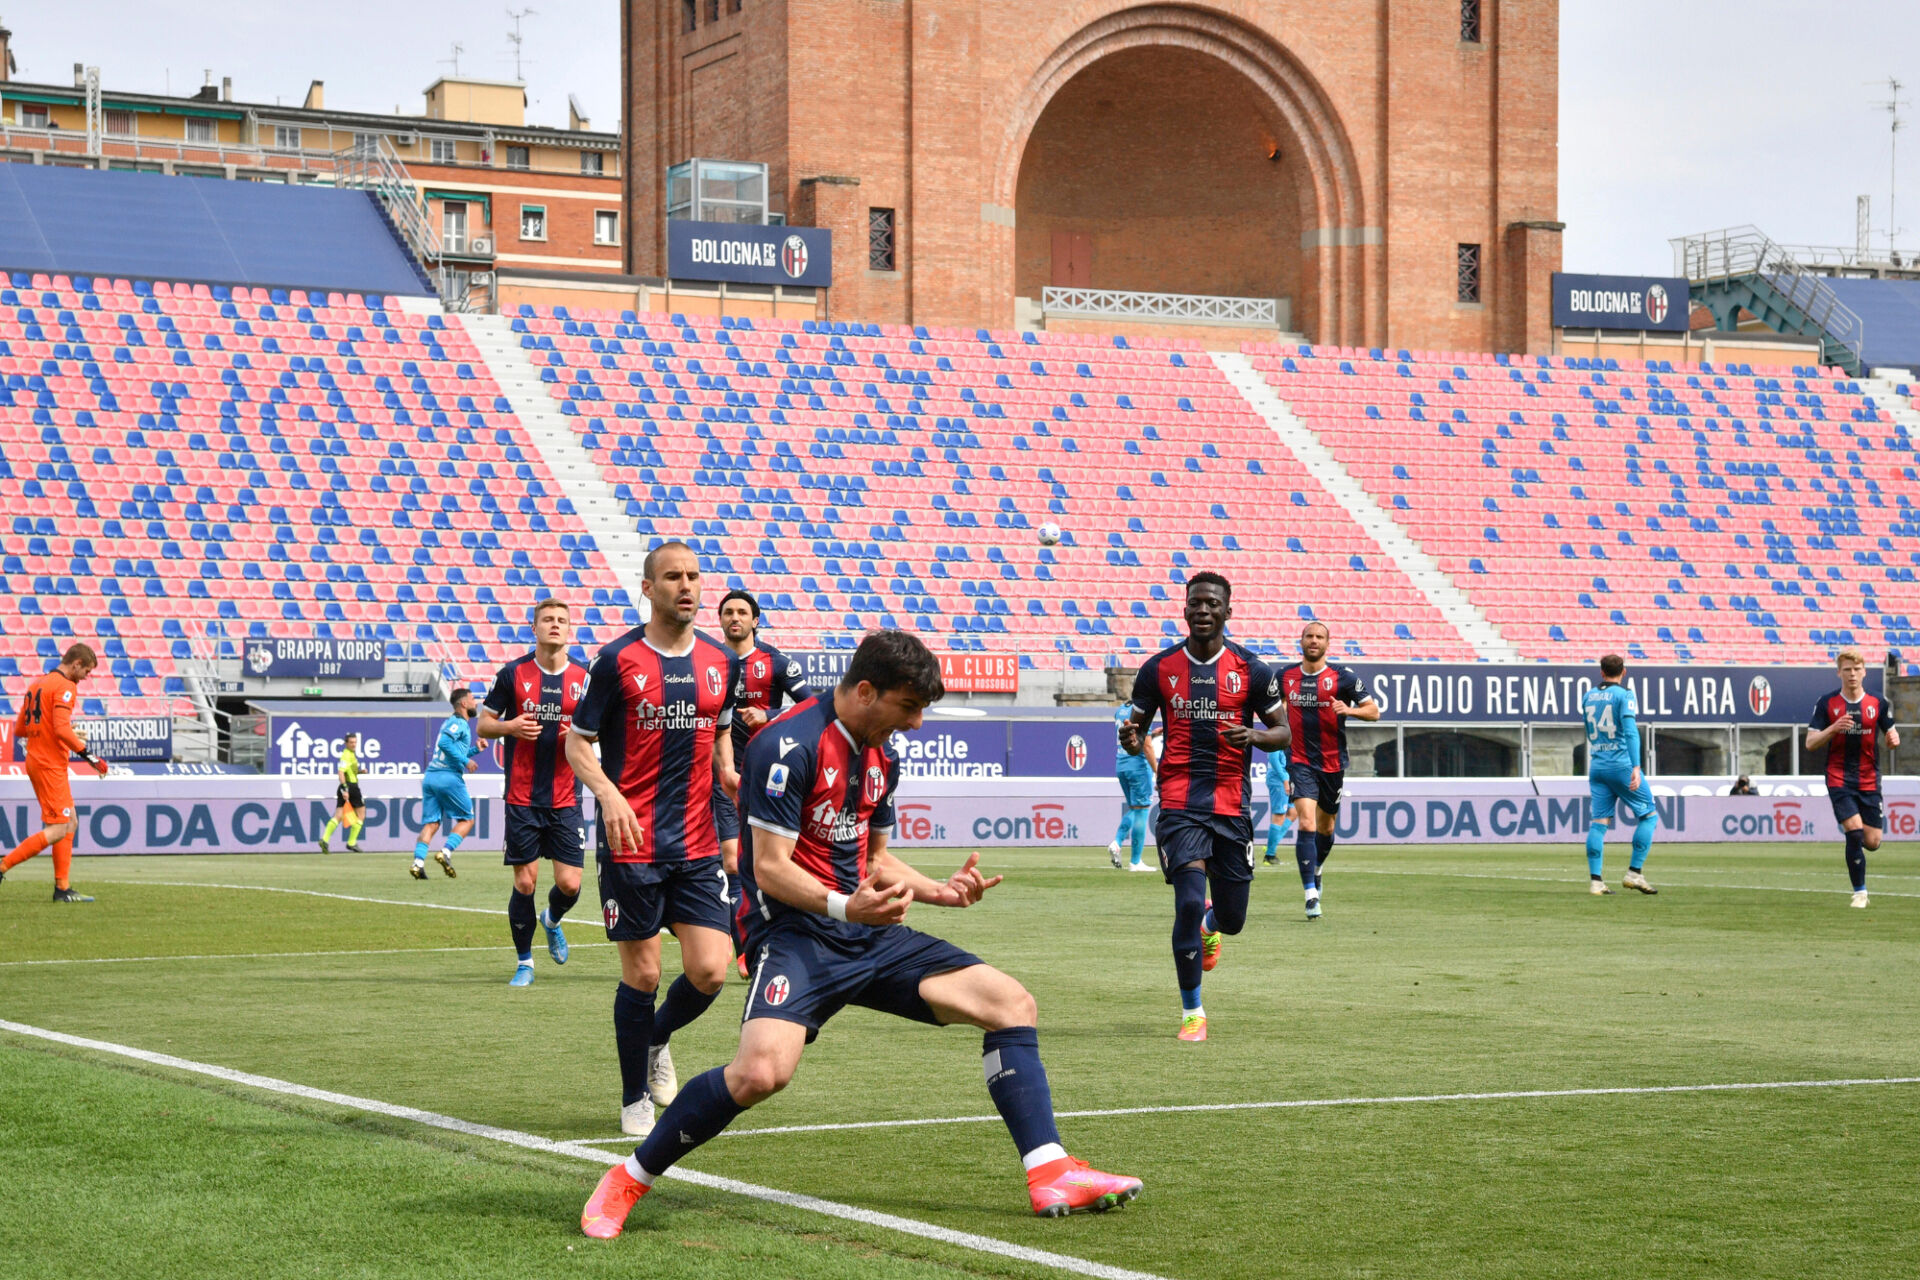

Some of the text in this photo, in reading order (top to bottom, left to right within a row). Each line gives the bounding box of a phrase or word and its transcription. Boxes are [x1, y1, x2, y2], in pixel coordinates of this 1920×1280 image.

[691, 238, 776, 266] BOLOGNA FC
[1570, 289, 1641, 313] BOLOGNA FC
[277, 640, 382, 661] GRAPPA KORPS
[807, 655, 853, 673] CENT
[807, 675, 844, 687] ASSOCIA
[964, 658, 1015, 676] CLUBS
[941, 678, 972, 689] EMORIA
[1373, 674, 1736, 715] STADIO RENATO ALL'ARA
[108, 719, 168, 740] ROSSOBLU
[1585, 704, 1617, 740] 34
[276, 721, 381, 758] facle
[280, 758, 421, 775] ristruurare
[899, 757, 1003, 777] strutturare
[146, 803, 220, 848] DA
[891, 810, 946, 840] te.it
[972, 810, 1079, 840] conte.it
[1427, 799, 1482, 837] DA
[1489, 795, 1686, 837] CAMONI
[1721, 807, 1814, 836] conte.it
[716, 869, 731, 905] 2
